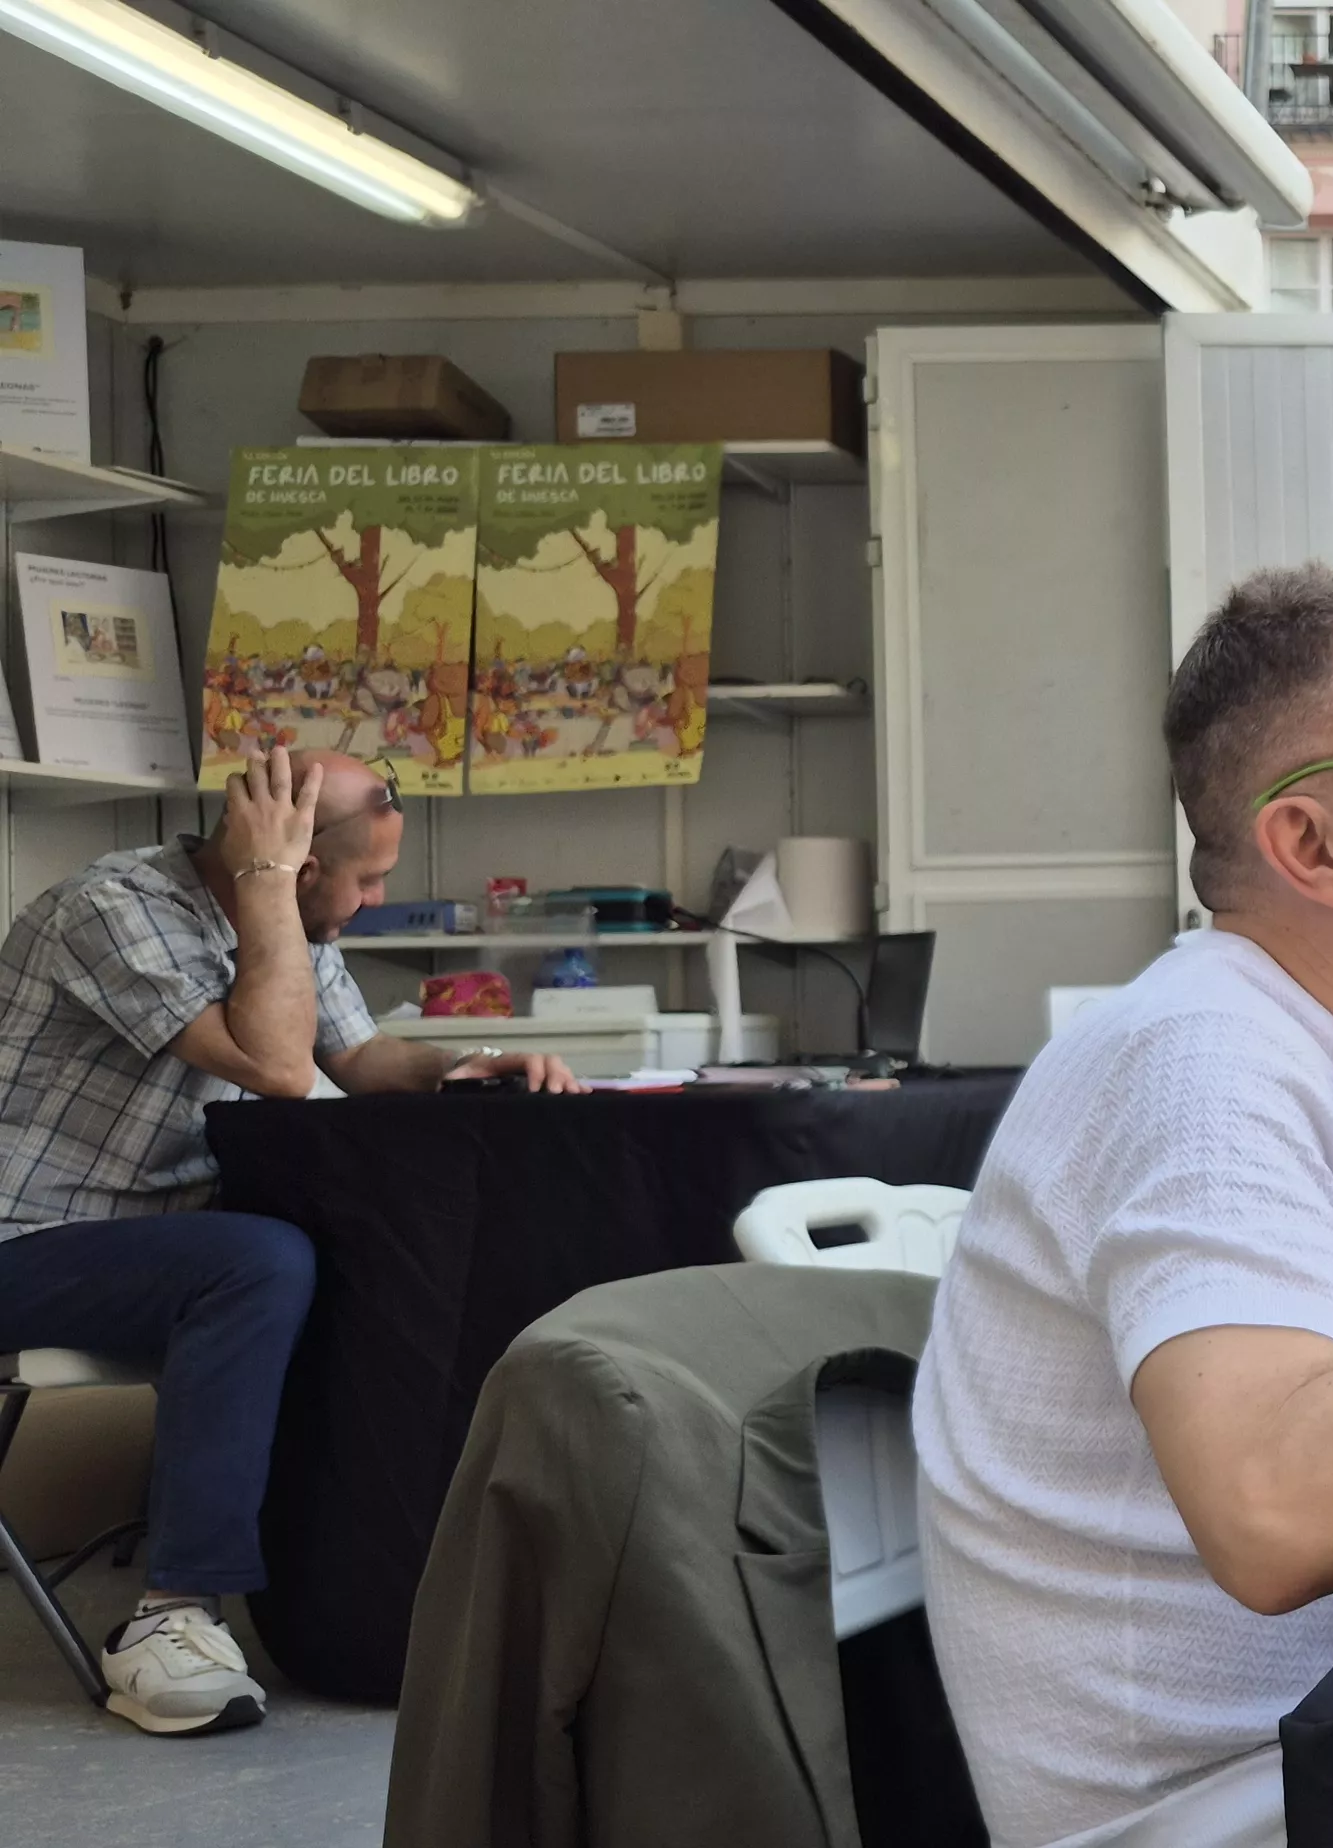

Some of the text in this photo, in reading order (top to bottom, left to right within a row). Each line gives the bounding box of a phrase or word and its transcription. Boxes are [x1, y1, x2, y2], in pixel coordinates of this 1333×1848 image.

[249, 464, 459, 486] FERIA DEL LIBRO
[498, 461, 707, 485] FERIA DEL LIBRO
[246, 489, 328, 503] DE HUESCA
[496, 487, 579, 502] DE HUESCA
